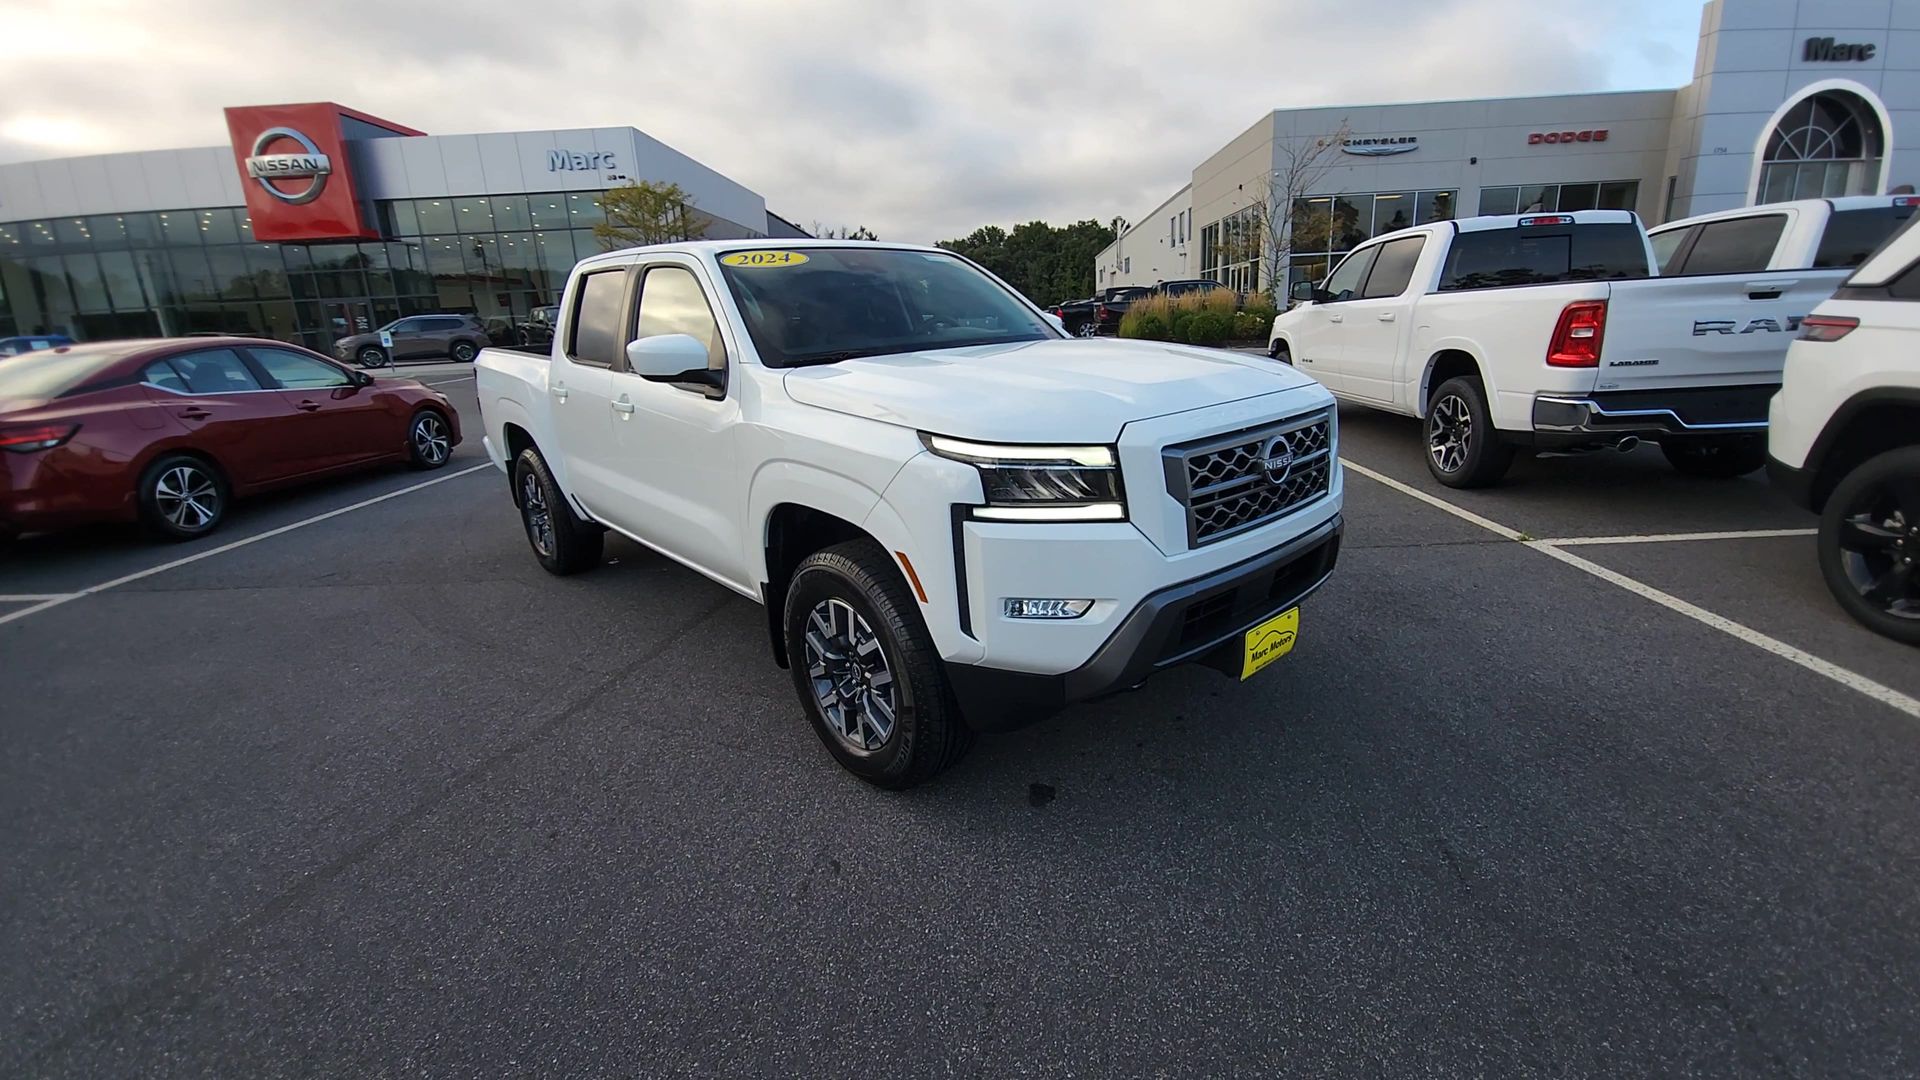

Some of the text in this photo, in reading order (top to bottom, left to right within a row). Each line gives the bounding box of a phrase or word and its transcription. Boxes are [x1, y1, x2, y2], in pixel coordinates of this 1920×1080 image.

[1803, 37, 1876, 62] Marc
[1343, 137, 1417, 146] CHRYSLER
[1528, 130, 1608, 144] DODGE
[252, 158, 319, 172] NISSAN
[547, 149, 617, 172] Marc
[737, 253, 791, 265] 2024
[1264, 454, 1293, 470] NISS
[1251, 648, 1269, 663] Marc
[1270, 634, 1293, 652] Motors
